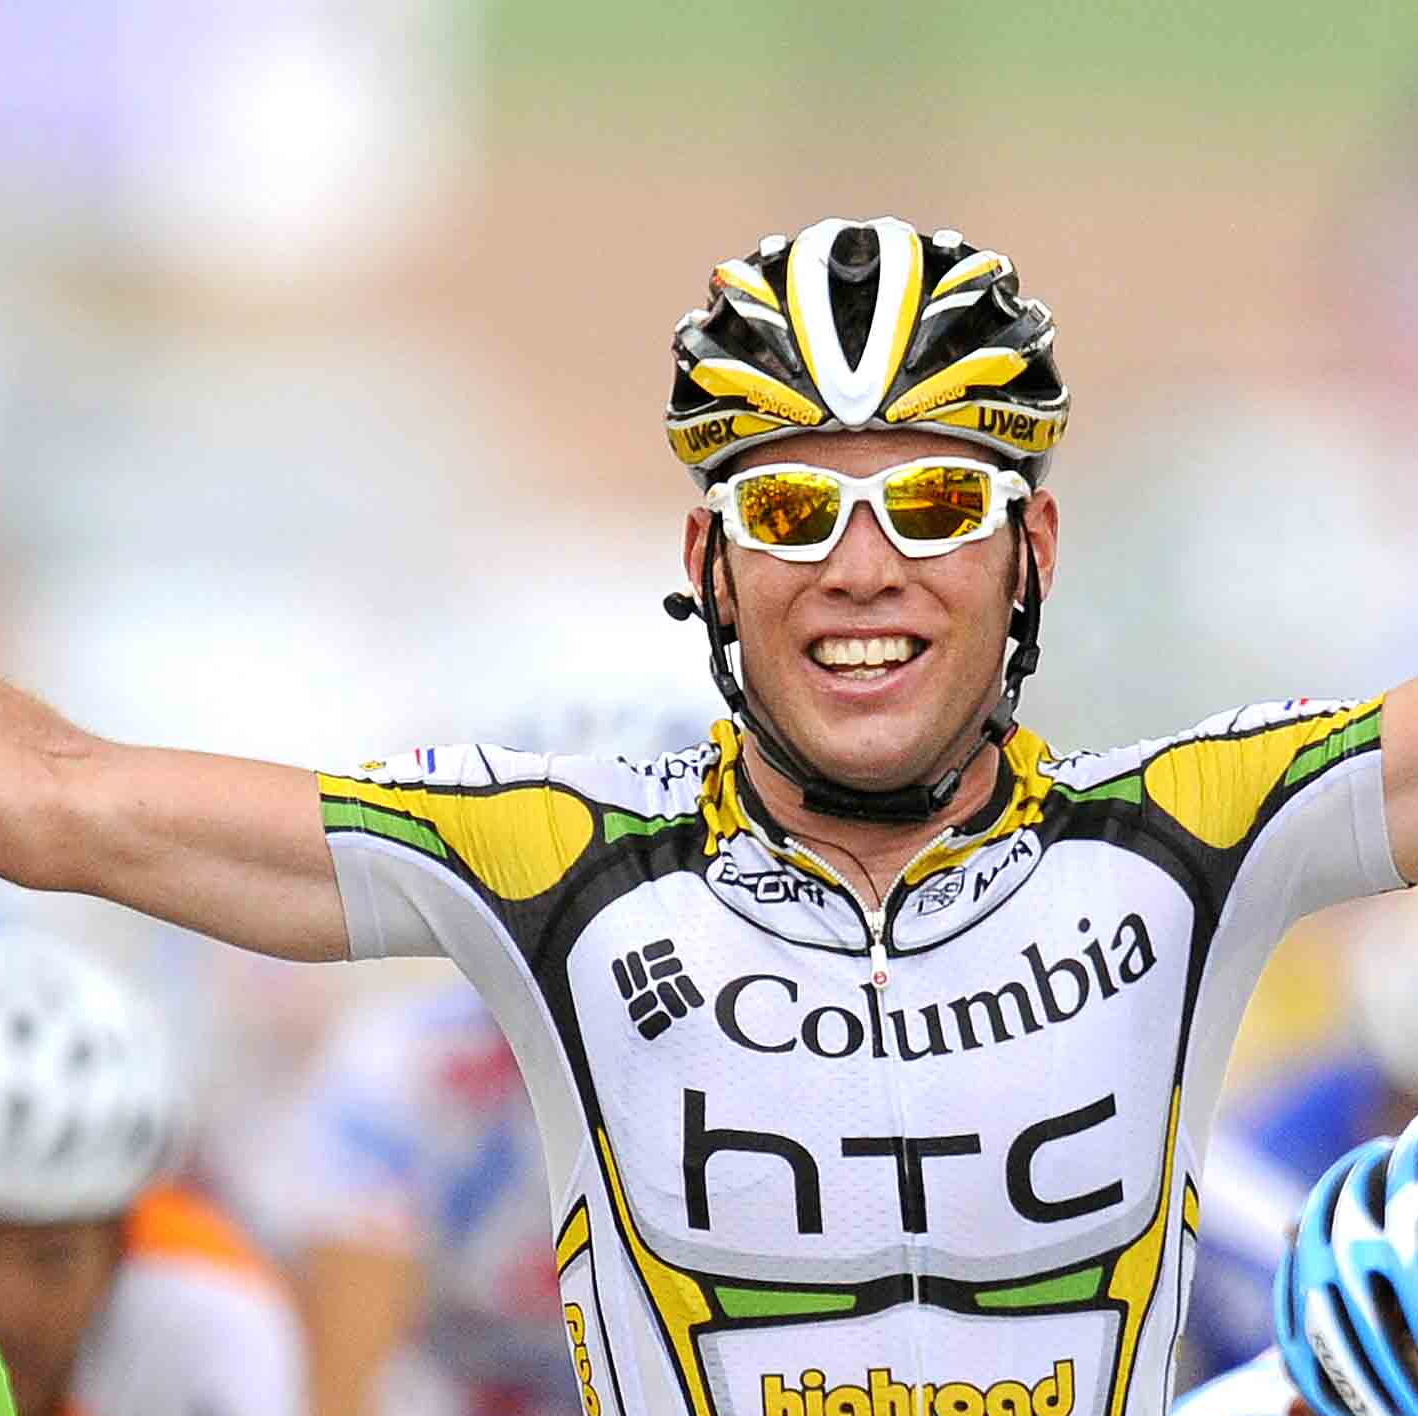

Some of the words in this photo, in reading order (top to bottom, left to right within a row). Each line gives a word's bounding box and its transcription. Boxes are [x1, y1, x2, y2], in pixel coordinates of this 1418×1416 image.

[683, 420, 739, 452] uvex
[978, 407, 1039, 442] uvex
[714, 912, 1158, 1062] Columbia
